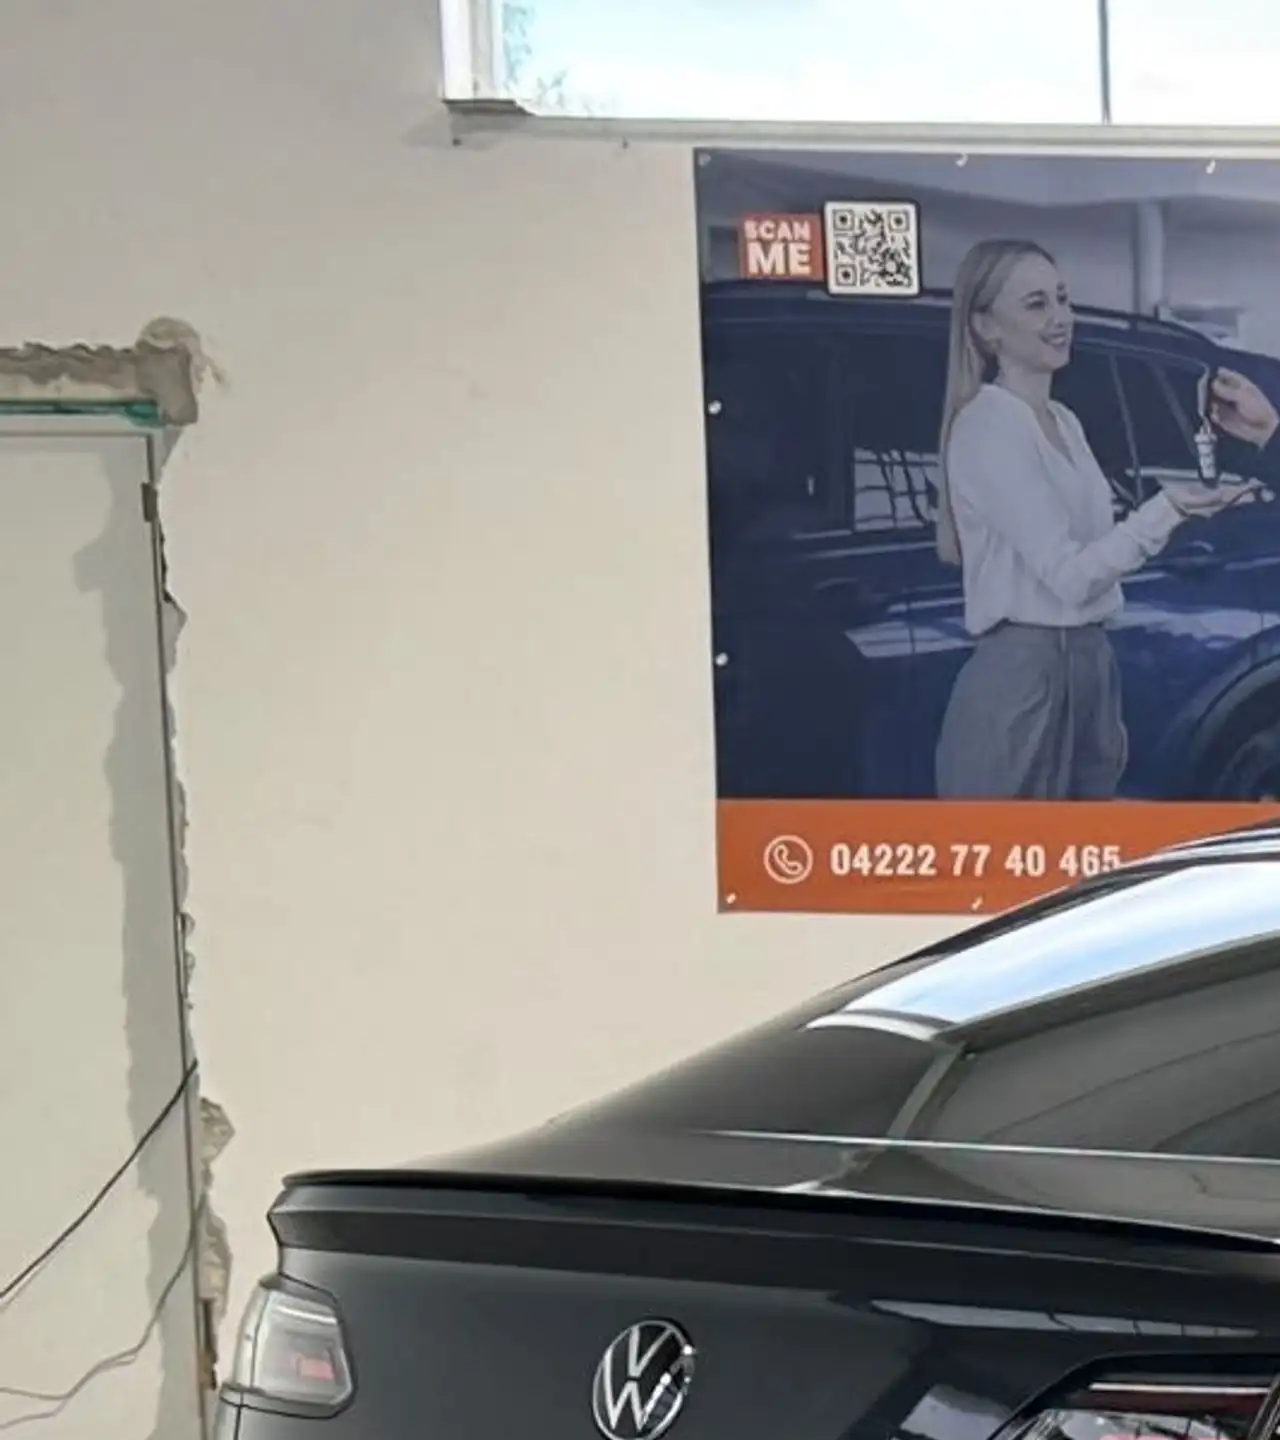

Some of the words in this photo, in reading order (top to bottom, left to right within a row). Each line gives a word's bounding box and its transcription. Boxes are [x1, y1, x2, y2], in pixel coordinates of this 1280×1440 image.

[744, 219, 811, 241] SCAN
[747, 242, 812, 276] ME
[829, 842, 938, 877] 04222
[950, 843, 989, 878] 77
[1004, 844, 1047, 878] 40
[1060, 844, 1121, 878] 465
